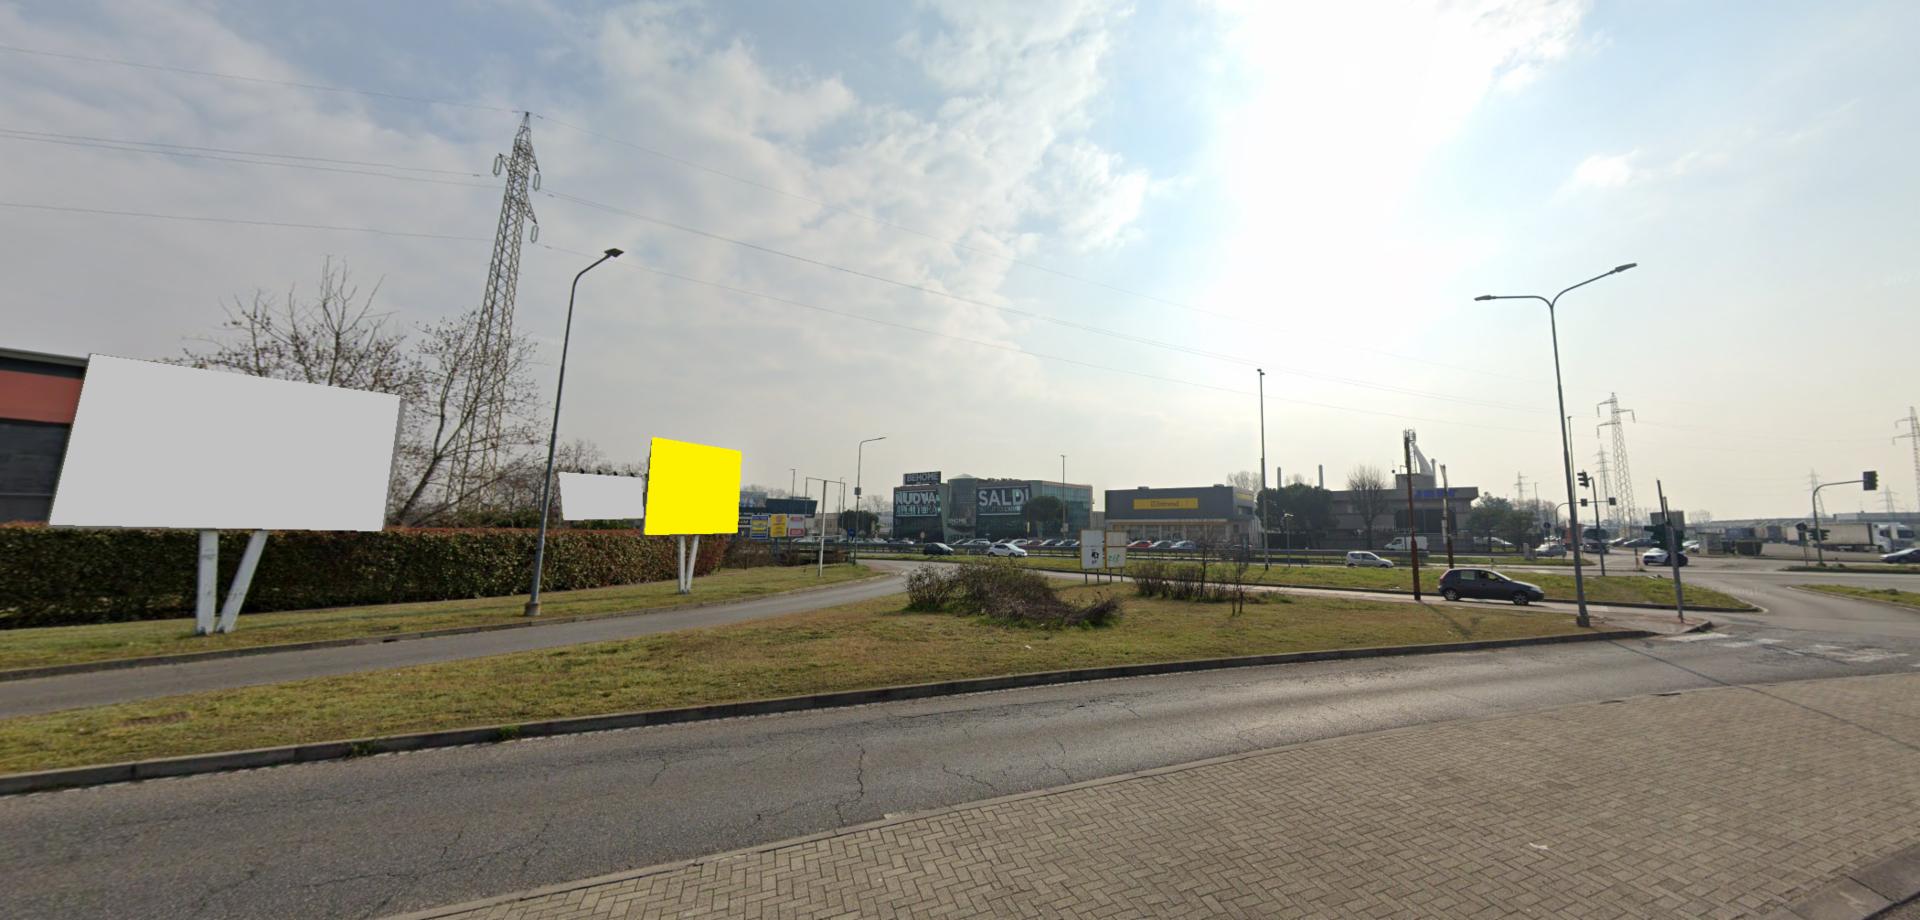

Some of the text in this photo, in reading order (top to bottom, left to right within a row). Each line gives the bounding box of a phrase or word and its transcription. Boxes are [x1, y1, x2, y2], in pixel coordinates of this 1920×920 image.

[907, 472, 939, 482] BEHOME
[895, 491, 937, 505] NUOVA
[978, 488, 1030, 507] SALDI
